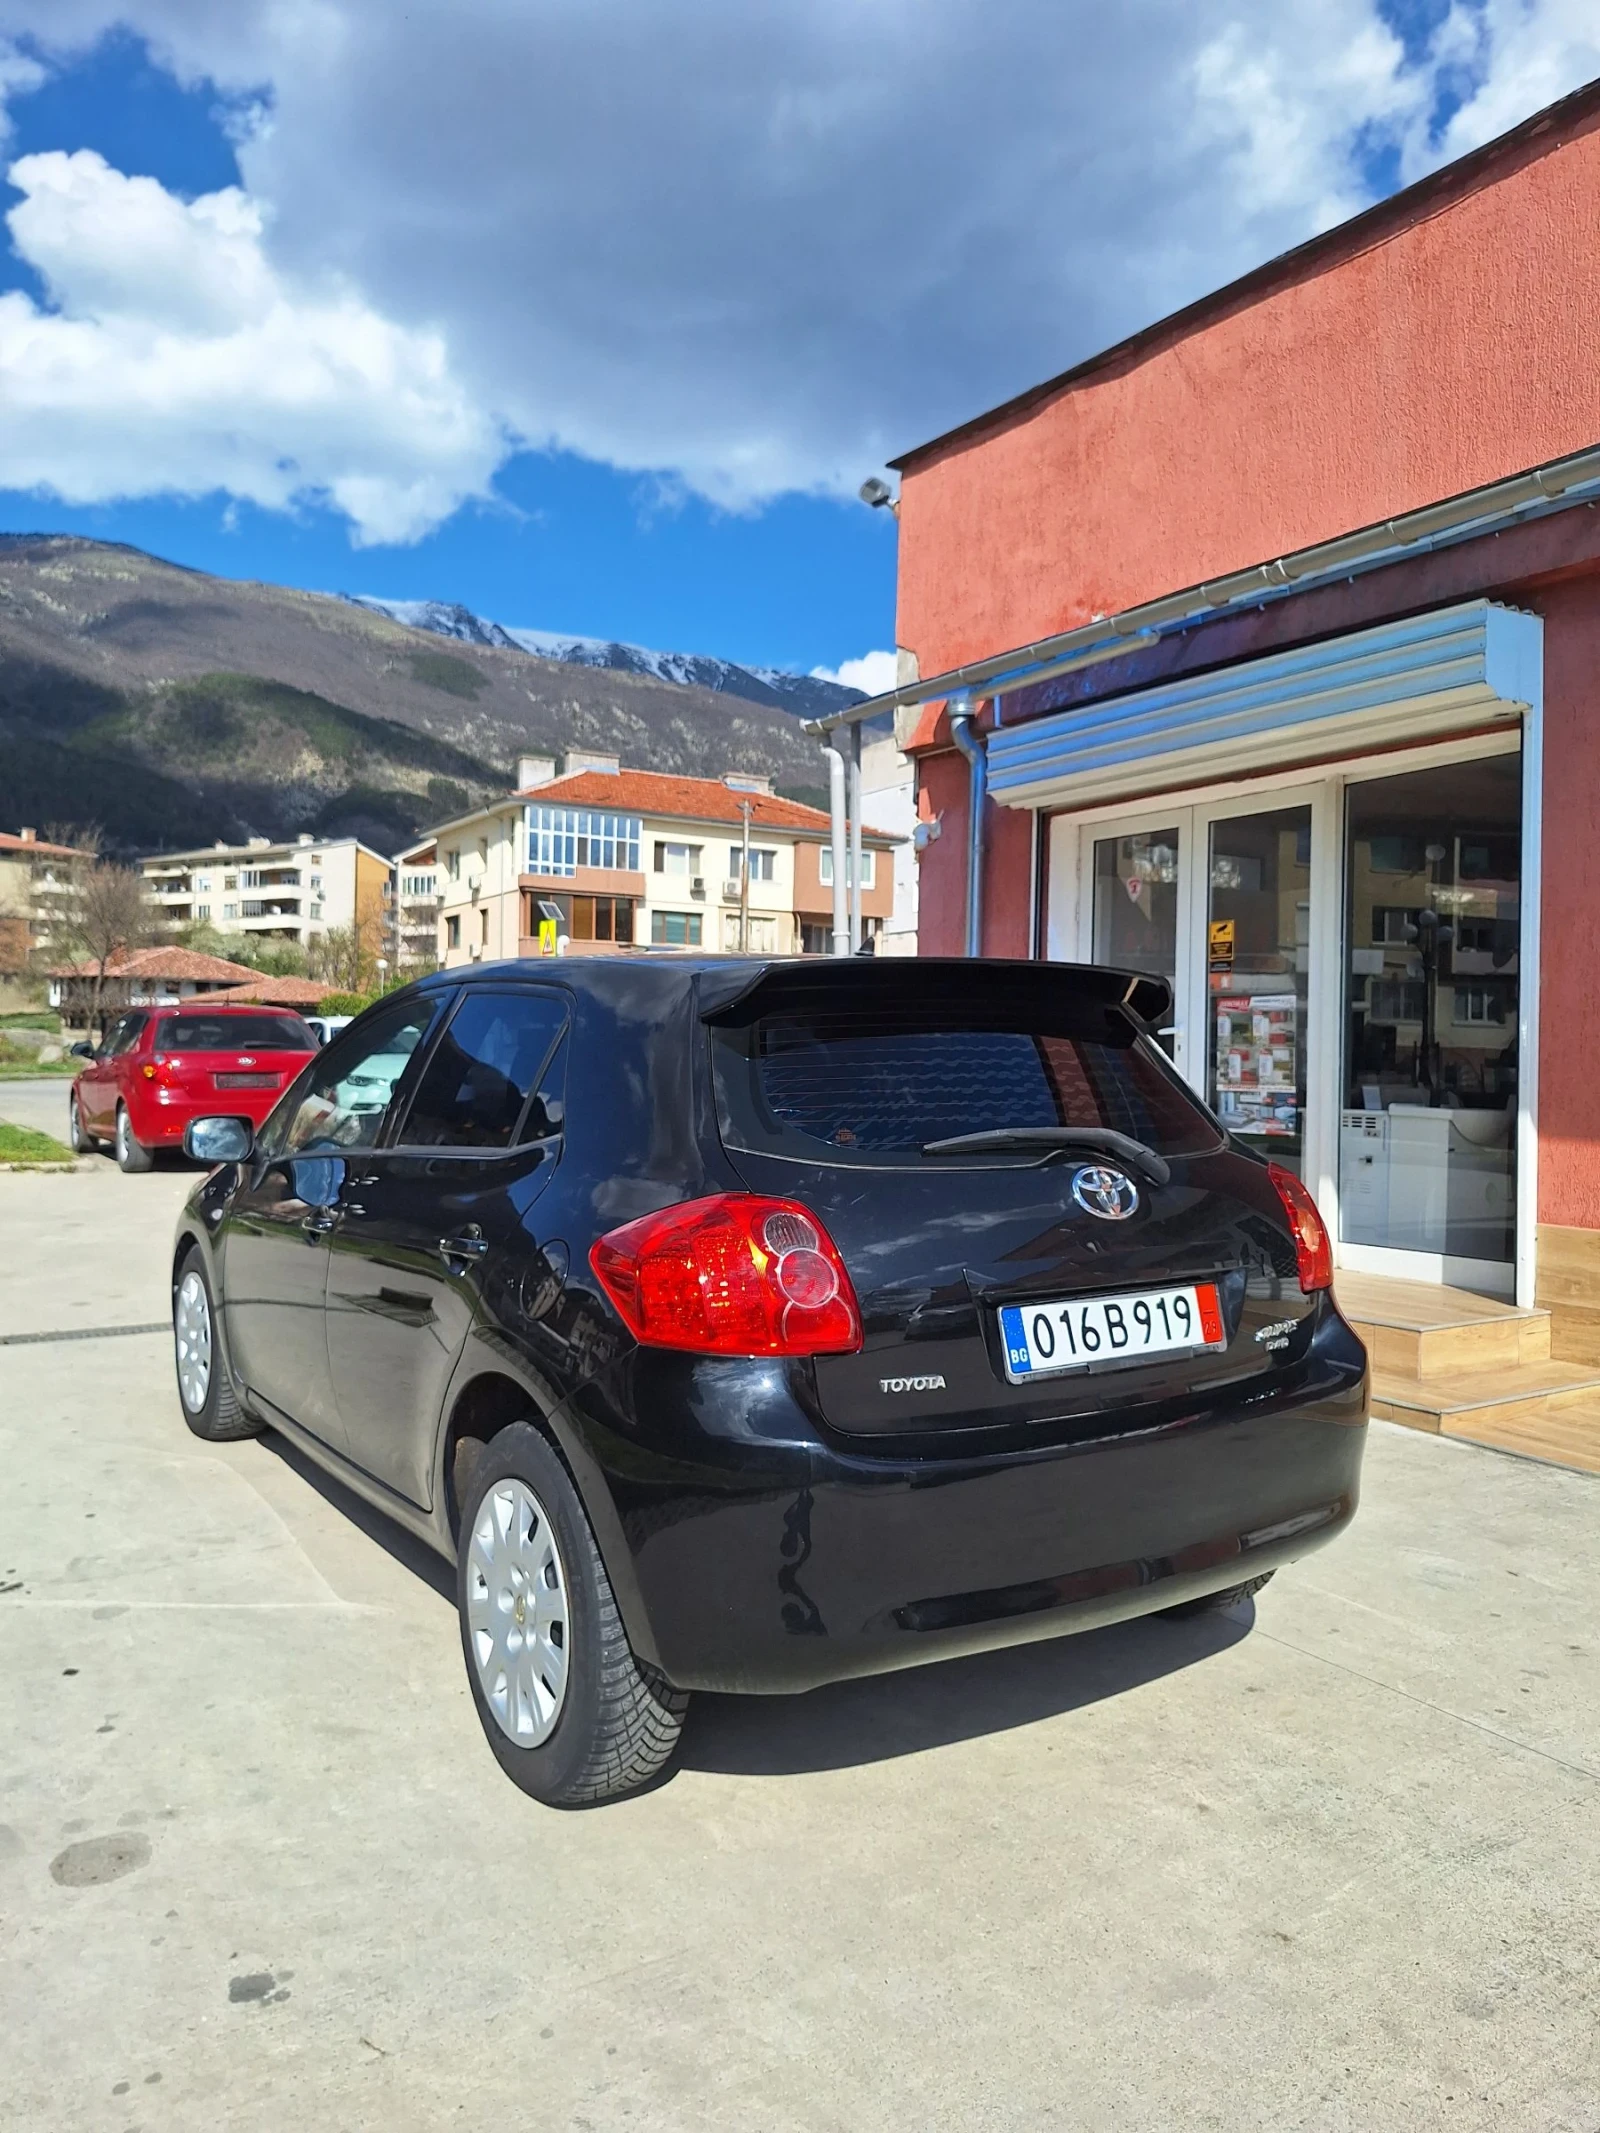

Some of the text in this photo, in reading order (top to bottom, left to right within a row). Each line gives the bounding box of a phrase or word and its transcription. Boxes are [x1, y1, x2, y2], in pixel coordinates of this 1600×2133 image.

[1033, 1295, 1191, 1358] 016B919
[1205, 1320, 1217, 1335] 29
[1010, 1348, 1028, 1363] BG
[879, 1375, 947, 1393] TOYOTA
